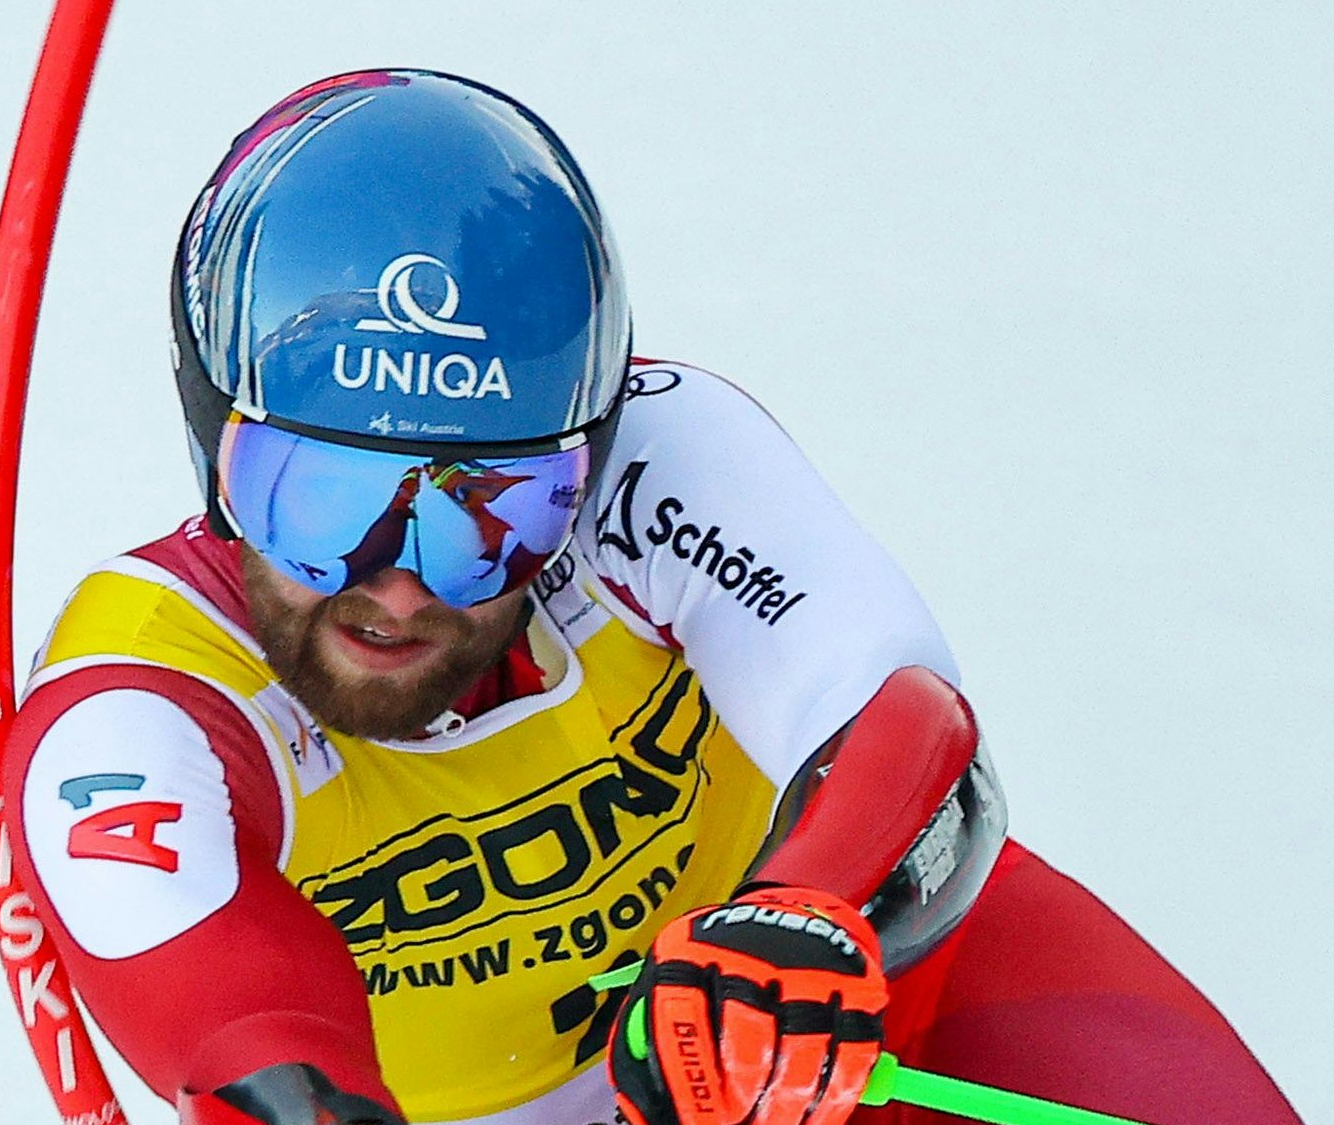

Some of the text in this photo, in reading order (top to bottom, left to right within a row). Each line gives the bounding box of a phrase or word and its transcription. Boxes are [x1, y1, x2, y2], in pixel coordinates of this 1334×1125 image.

[332, 343, 512, 401] UNIQA
[58, 773, 183, 873] A1
[672, 1020, 715, 1114] racing
